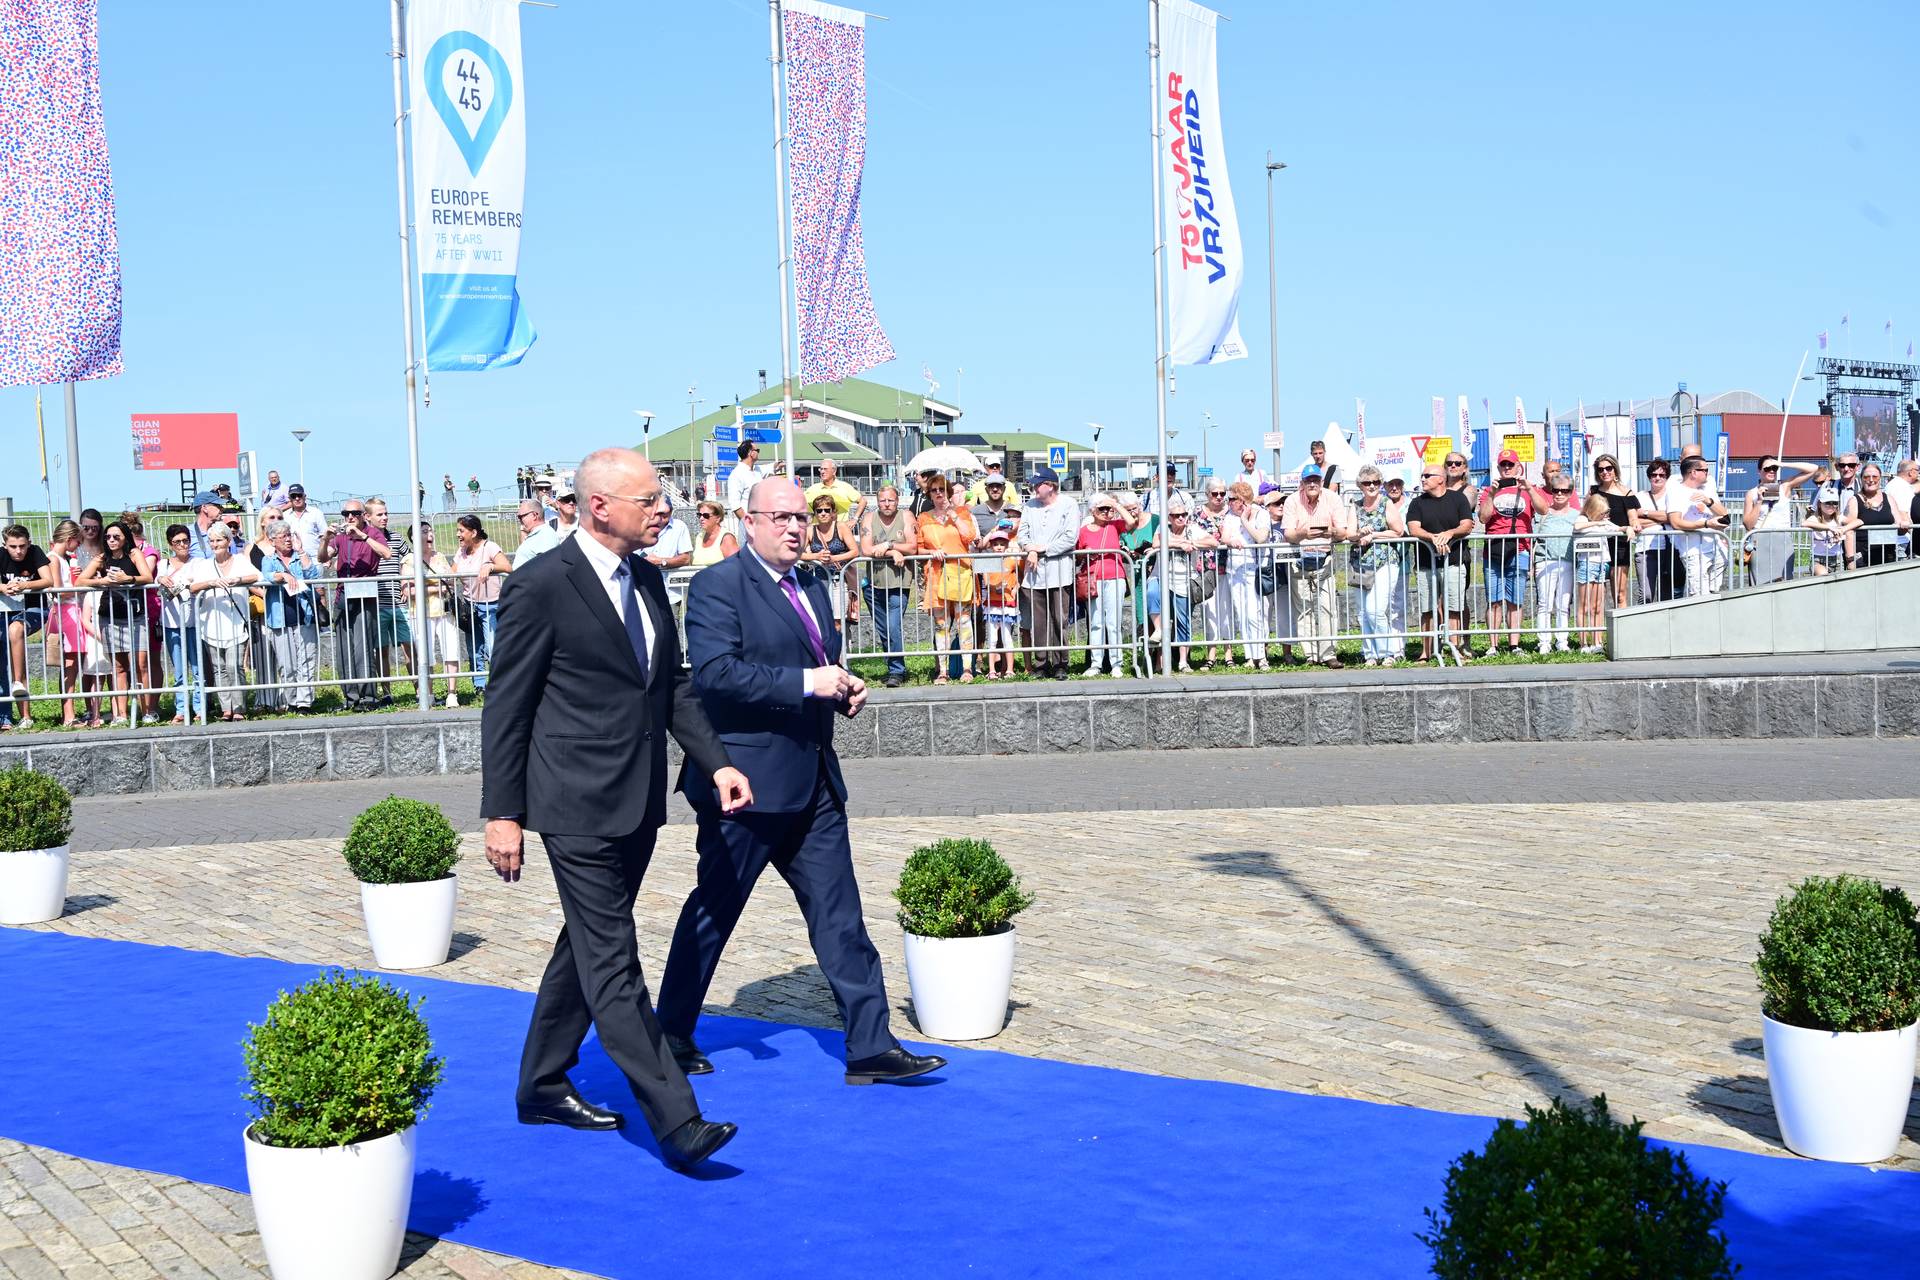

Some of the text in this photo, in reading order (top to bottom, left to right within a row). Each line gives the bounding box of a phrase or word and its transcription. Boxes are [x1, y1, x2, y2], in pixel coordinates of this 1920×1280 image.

[456, 58, 480, 84] 44
[458, 86, 482, 112] 45
[1168, 71, 1203, 270] 75 JAAR
[431, 188, 490, 208] EUROPE
[432, 209, 522, 229] REMEMBERS
[434, 233, 483, 246] 75 YEARS
[436, 248, 503, 262] AFTER WWII
[1388, 451, 1406, 459] JAAR
